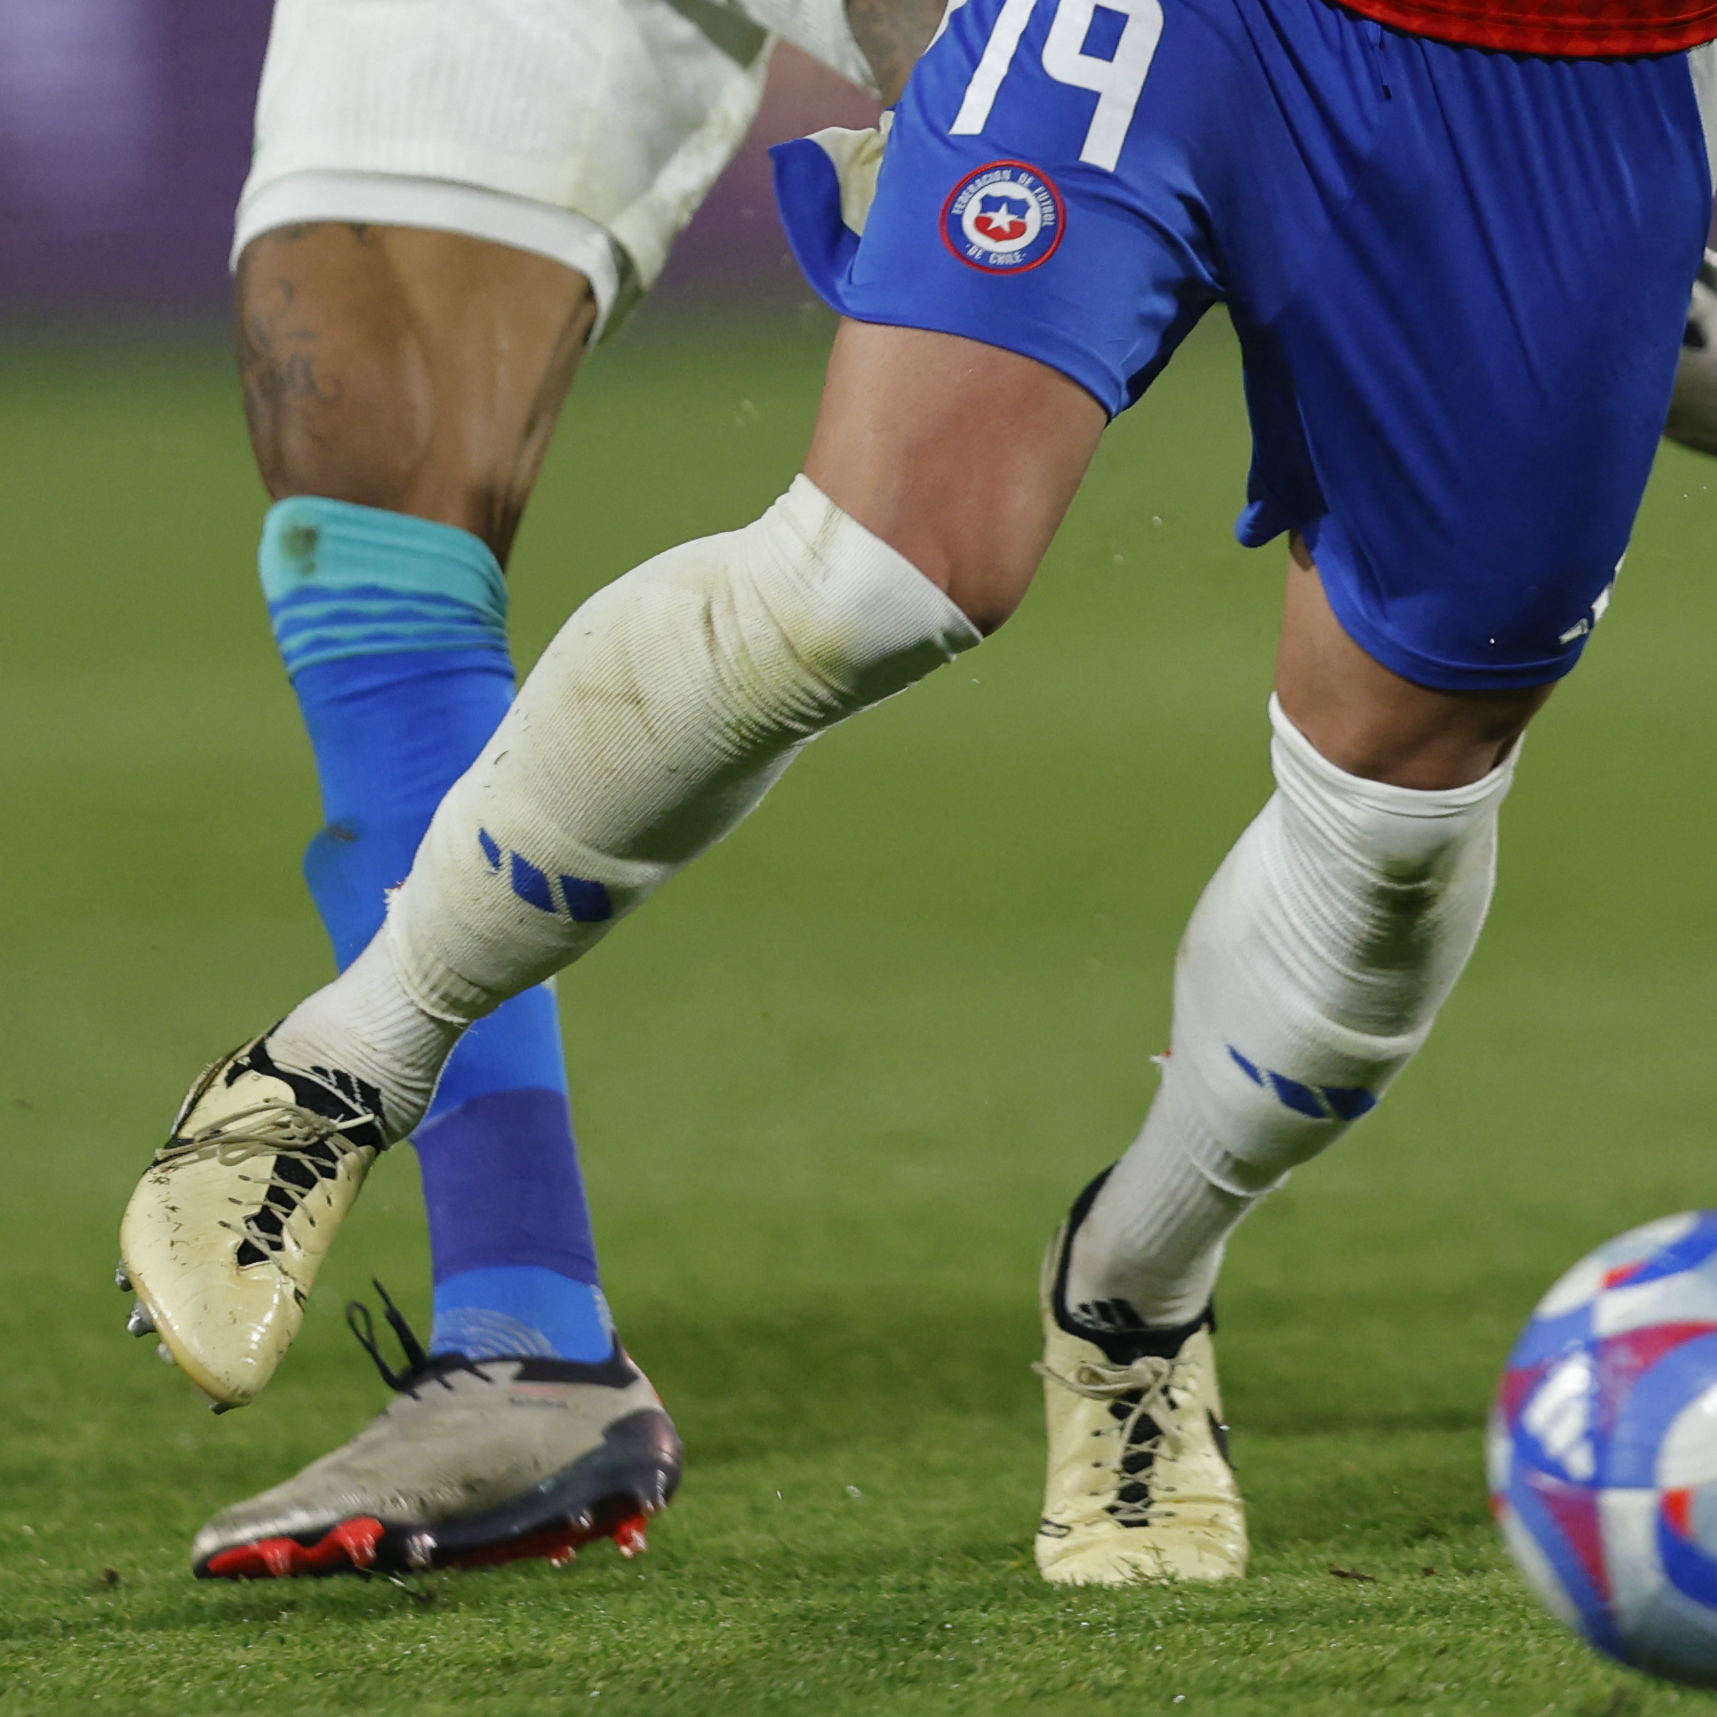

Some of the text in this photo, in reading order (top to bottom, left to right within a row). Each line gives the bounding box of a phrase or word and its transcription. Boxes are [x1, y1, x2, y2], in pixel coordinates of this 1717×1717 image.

[951, 169, 1012, 216] FEDERACION
[1017, 171, 1036, 188] DE
[989, 251, 1024, 265] CHILE
